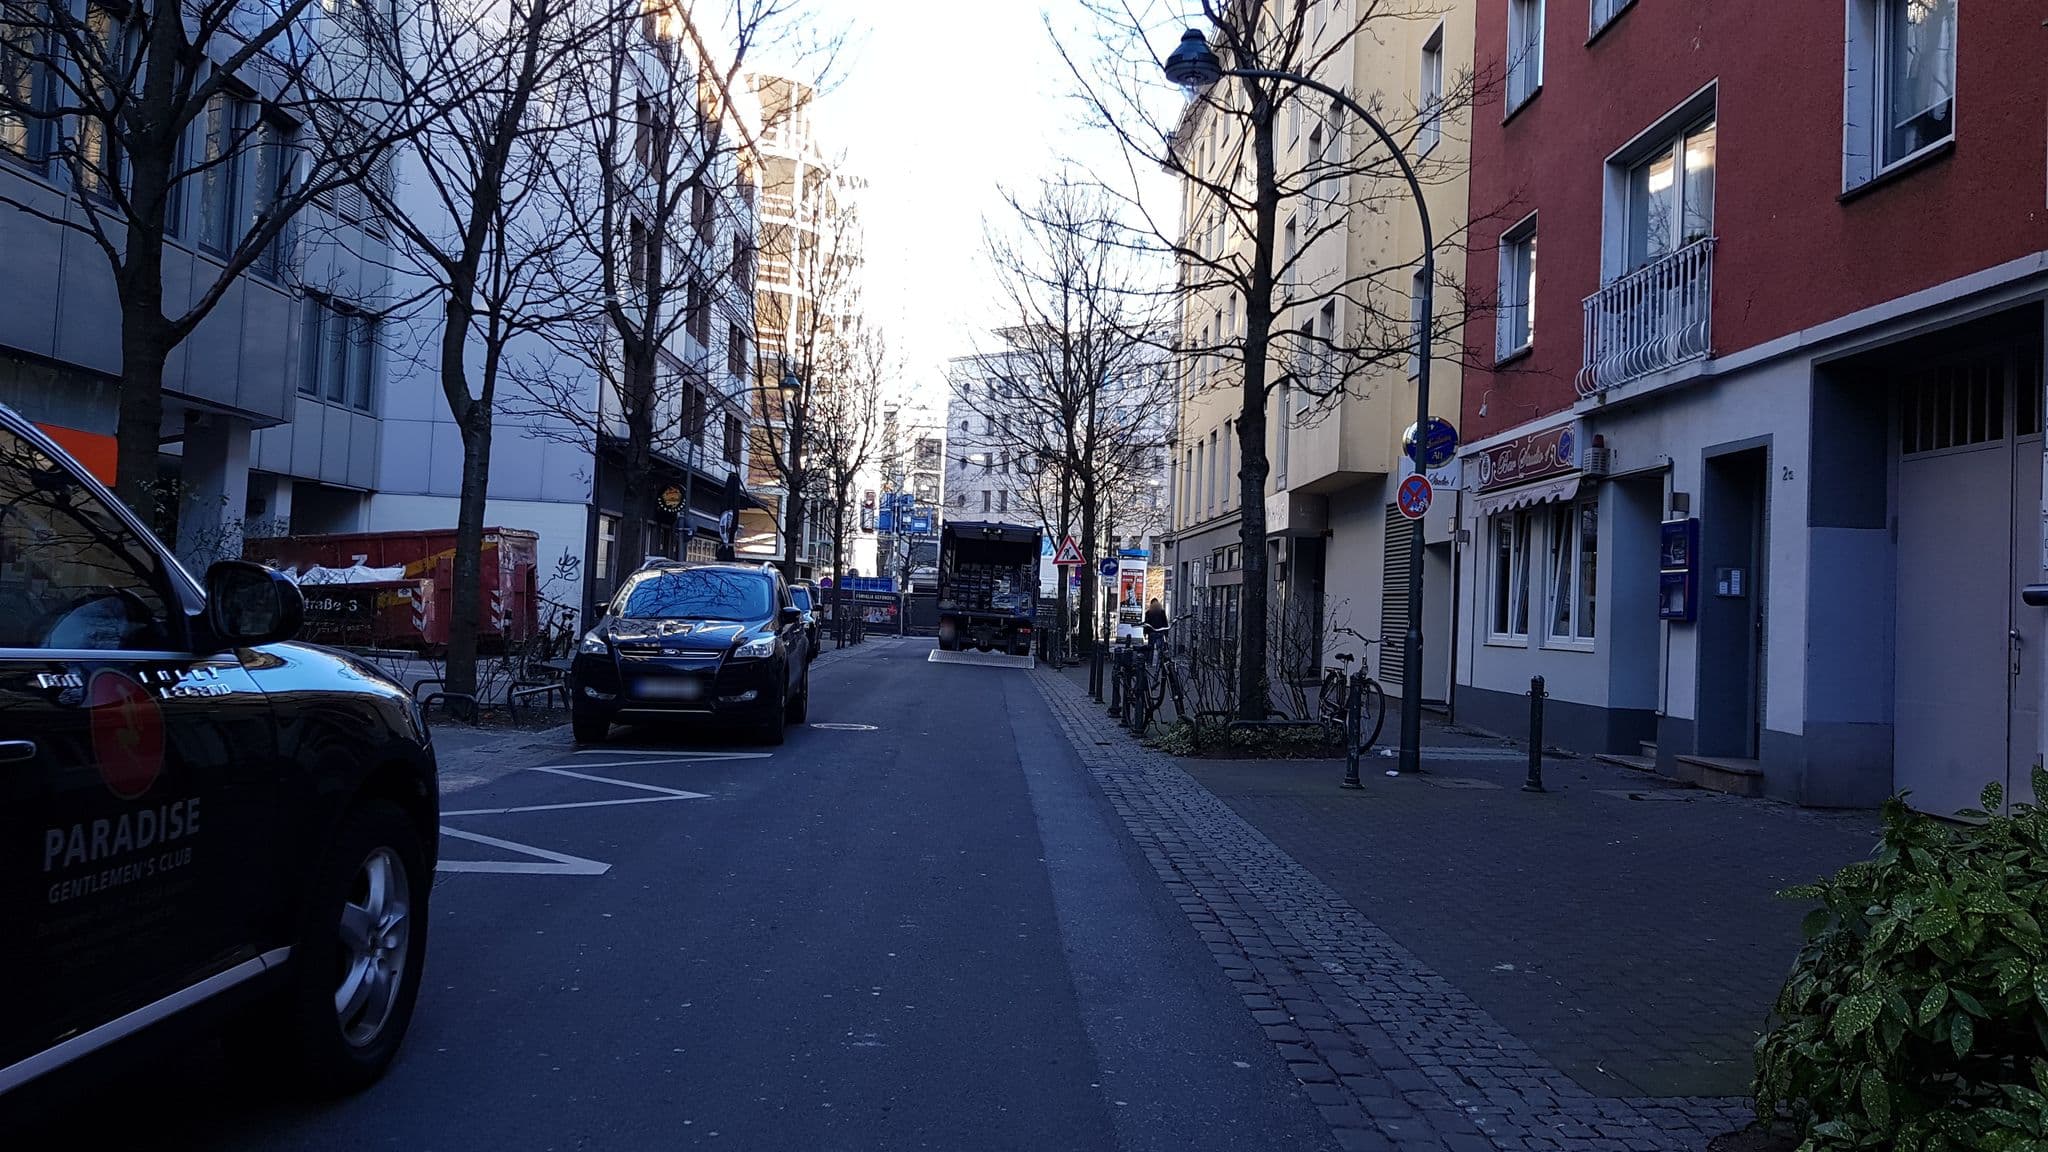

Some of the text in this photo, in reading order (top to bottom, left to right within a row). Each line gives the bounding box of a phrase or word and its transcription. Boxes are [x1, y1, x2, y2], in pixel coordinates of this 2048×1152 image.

[1497, 449, 1517, 475] Bar
[1518, 444, 1544, 470] Studio
[44, 797, 201, 872] PARADISE
[48, 847, 193, 905] GENTLEMEN'S CLUB
